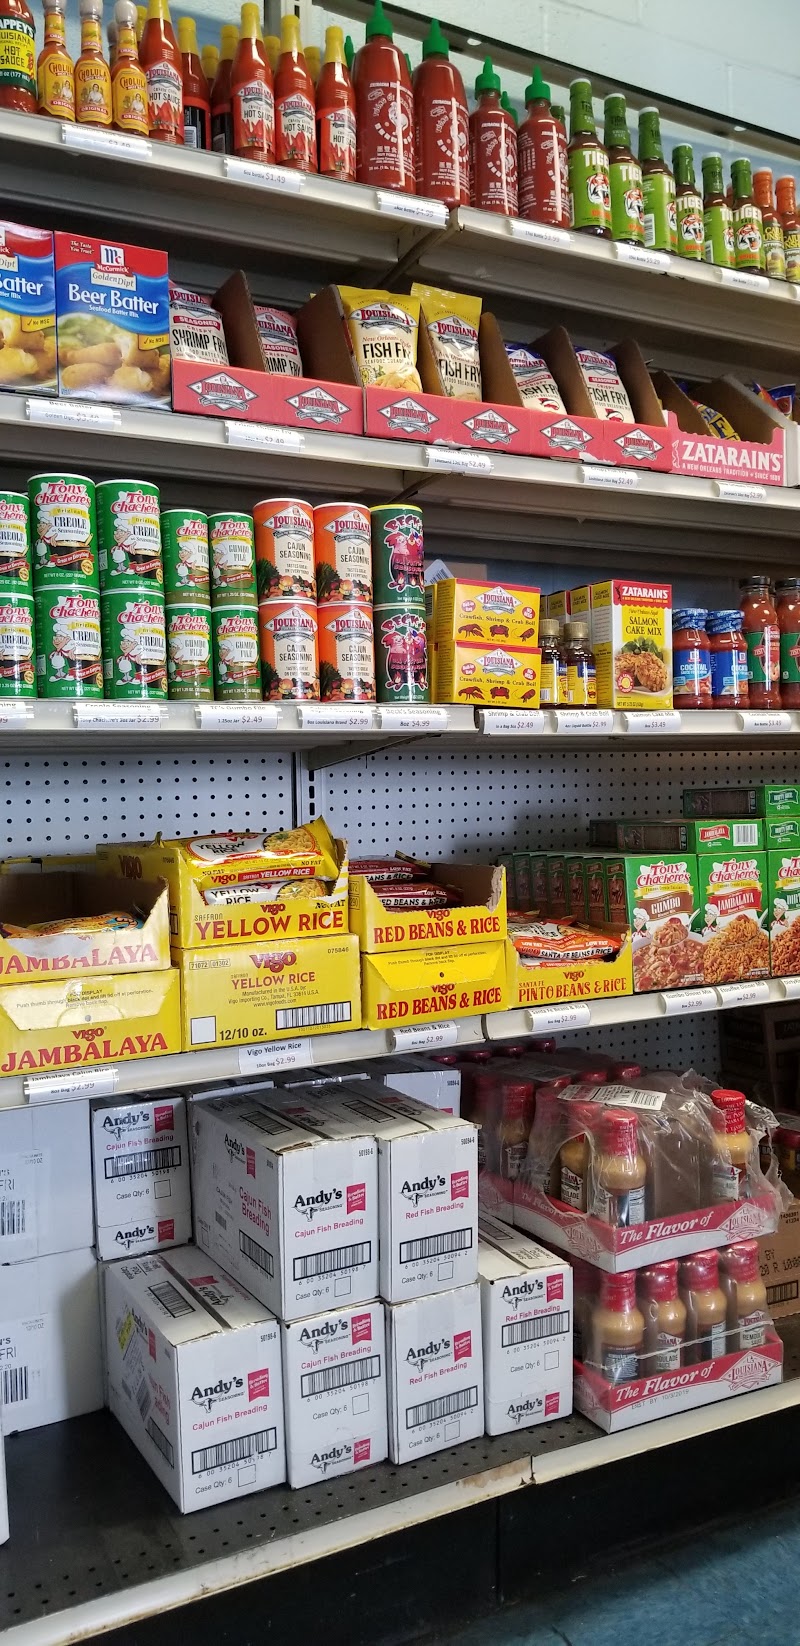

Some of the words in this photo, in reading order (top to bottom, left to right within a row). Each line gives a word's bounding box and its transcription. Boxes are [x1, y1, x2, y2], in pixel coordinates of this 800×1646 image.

[4, 45, 20, 56] HOT
[0, 55, 25, 67] SAUCE
[150, 92, 161, 102] HOT
[163, 93, 181, 108] SAUCE
[284, 123, 296, 132] HOT
[297, 124, 314, 136] SAUCE
[333, 134, 345, 145] HOT
[97, 263, 129, 273] McCormick
[68, 283, 107, 304] Beer
[110, 290, 159, 315] Batter
[89, 304, 111, 314] Seafood
[112, 308, 129, 316] Batter
[130, 310, 139, 318] Mix
[179, 316, 218, 326] SEASONED
[187, 325, 212, 333] CRISPY
[437, 322, 478, 338] LOUISIANA
[172, 329, 210, 348] SHRIMP
[362, 343, 392, 359] FISH
[202, 381, 246, 399] LOUISIANA
[588, 386, 610, 402] FISH
[611, 390, 628, 405] FRY
[682, 440, 782, 471] ZATARAIN'S
[687, 463, 698, 471] NEW
[700, 465, 722, 474] ORLEANS
[723, 467, 749, 477] TRADITION
[754, 472, 768, 480] SINCE
[48, 480, 86, 494] Tony
[54, 517, 86, 529] CREOLE
[228, 544, 250, 554] GUMBO
[287, 542, 306, 550] CAJUN
[348, 547, 365, 555] CAJUN
[280, 550, 311, 561] SEASONING
[483, 593, 514, 606] LOUISIANA
[622, 586, 668, 599] ZATARAIN'S
[459, 613, 484, 621] Crawfish,
[629, 617, 658, 626] SALMON
[626, 626, 646, 635] CAKE
[647, 626, 662, 636] MIX
[185, 639, 206, 648] GUMBO
[348, 645, 366, 654] CAJUN
[279, 654, 313, 662] SEASONING
[242, 716, 263, 724] $2.49
[517, 721, 533, 729] $2.49
[196, 841, 246, 850] YELLOW
[651, 862, 684, 876] Tony
[722, 859, 756, 872] Tony
[637, 871, 690, 887] Chachere's
[709, 868, 760, 884] Chachere's
[651, 896, 681, 914] GUMBO
[717, 893, 754, 912] JAMBALAYA
[194, 913, 223, 921] SAFFRON
[196, 916, 291, 940] YELLOW
[299, 911, 344, 931] RICE
[373, 926, 405, 945] RED
[409, 922, 453, 941] BEANS
[457, 921, 467, 936] &
[470, 916, 500, 933] RICE
[232, 975, 285, 990] YELLOW
[289, 972, 316, 984] RICE
[519, 986, 554, 1003] PINTO
[555, 982, 591, 999] BEANS
[594, 980, 601, 994] &
[603, 978, 627, 992] RICE
[377, 1001, 409, 1020] RED
[412, 995, 456, 1016] BEANS
[459, 992, 470, 1008] &
[473, 987, 502, 1005] RICE
[688, 1000, 702, 1008] $2.99
[220, 1028, 248, 1041] 12/10
[252, 1027, 268, 1037] oz.
[400, 1026, 413, 1034] Red
[414, 1024, 433, 1032] Beans
[439, 1022, 450, 1030] Rice
[1, 1032, 169, 1073] JAMBALAYA
[247, 1048, 262, 1056] Vigo
[264, 1044, 286, 1053] Yellow
[288, 1042, 302, 1051] Rice
[103, 1111, 150, 1128] Andy's
[116, 1192, 131, 1200] Case
[133, 1190, 145, 1198] Qty:
[294, 1188, 342, 1208] Andy's
[239, 1186, 257, 1206] Cajun
[258, 1199, 272, 1220] Fish
[406, 1210, 418, 1220] Red
[420, 1206, 434, 1217] Fish
[436, 1201, 464, 1214] Breading
[242, 1204, 270, 1237] Breading
[295, 1227, 315, 1238] Cajun
[317, 1224, 332, 1234] Fish
[333, 1217, 364, 1231] Breading
[115, 1225, 155, 1241] Andy's
[620, 1229, 644, 1245] The
[646, 1214, 698, 1241] Flavor
[700, 1212, 714, 1226] of
[506, 1313, 518, 1322] Red
[520, 1311, 532, 1320] Fish
[534, 1304, 561, 1318] Breading
[301, 1359, 322, 1370] Cajun
[323, 1354, 339, 1363] Fish
[340, 1346, 372, 1359] Breading
[410, 1376, 422, 1385] Red
[424, 1372, 438, 1381] Fish
[440, 1362, 467, 1376] Breading
[616, 1386, 640, 1402] The
[643, 1371, 699, 1396] Flavor
[700, 1362, 714, 1378] of
[732, 1360, 770, 1380] LOUISIANA
[191, 1376, 244, 1399] Andy's
[192, 1418, 214, 1431] Cajun
[216, 1413, 233, 1425] Fish
[234, 1403, 268, 1419] Breading
[312, 1411, 328, 1420] Case
[330, 1406, 342, 1416] Qty:
[311, 1445, 352, 1463] Andy's
[195, 1483, 212, 1495] Case
[213, 1480, 226, 1490] Qty:
